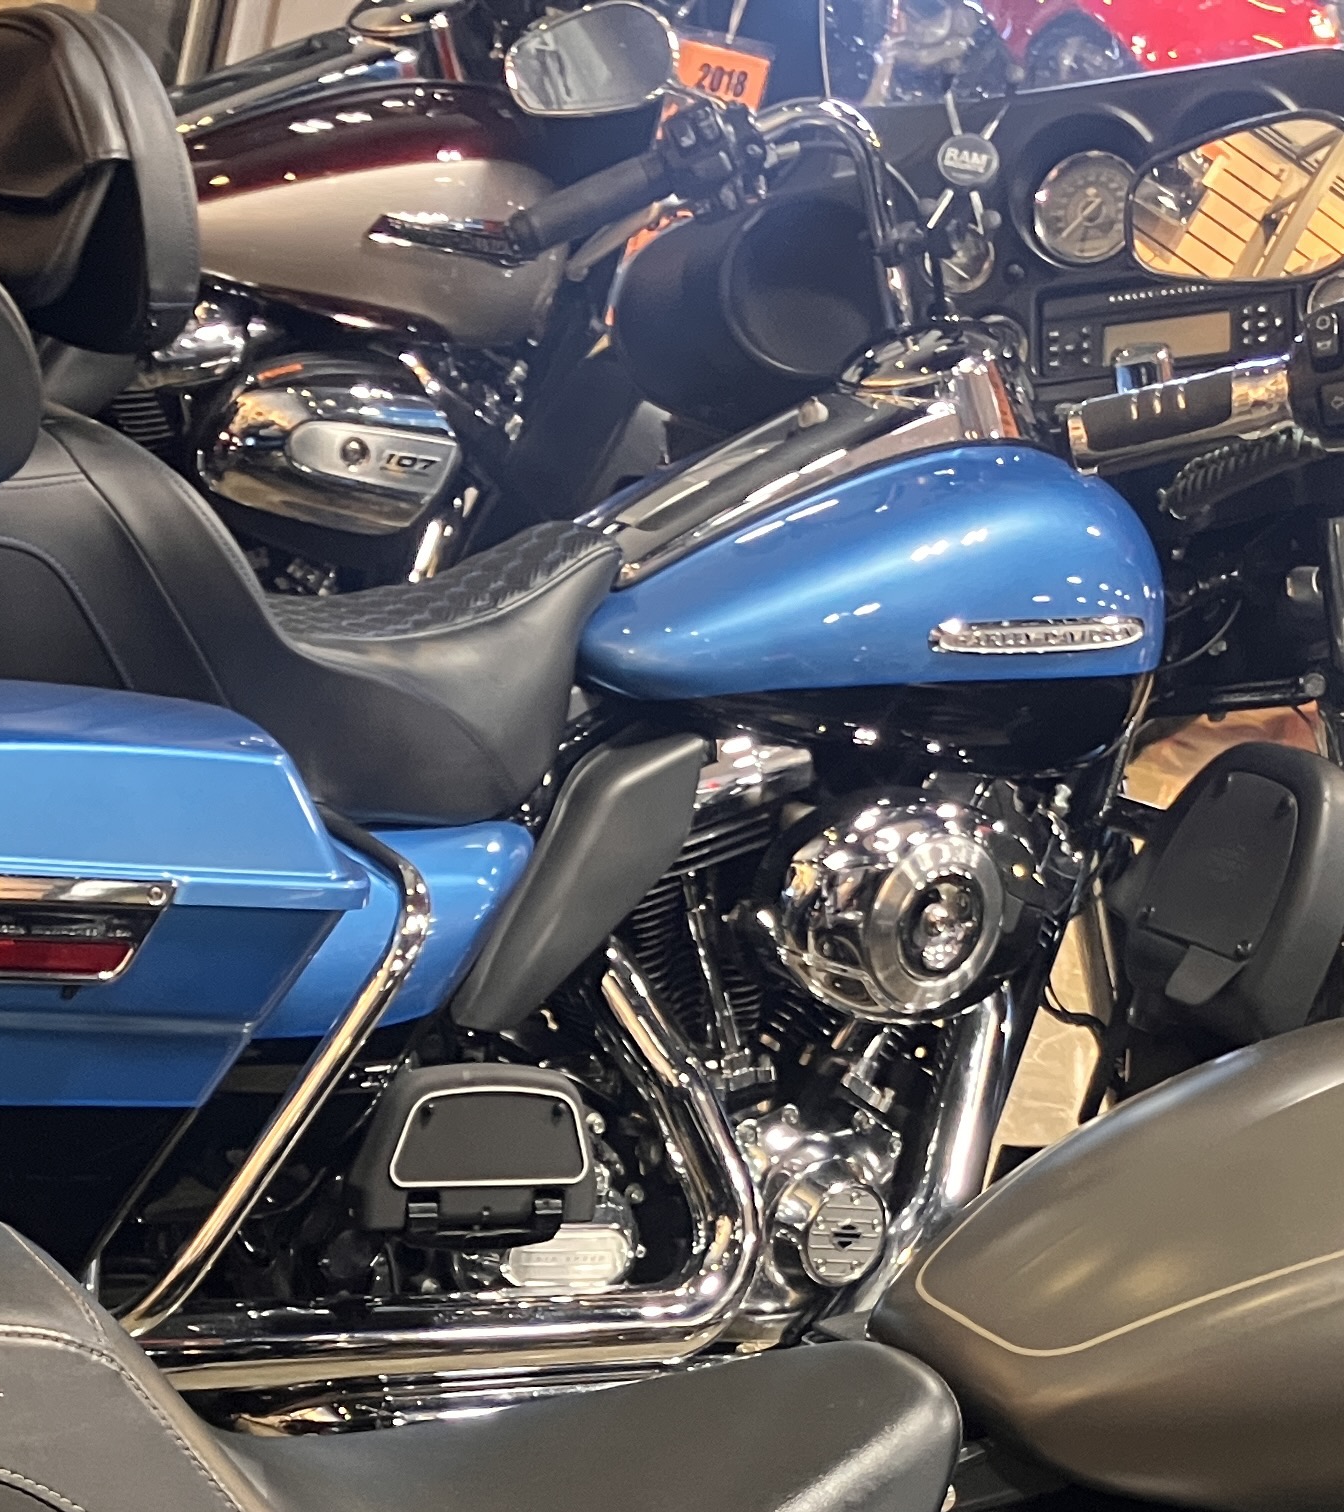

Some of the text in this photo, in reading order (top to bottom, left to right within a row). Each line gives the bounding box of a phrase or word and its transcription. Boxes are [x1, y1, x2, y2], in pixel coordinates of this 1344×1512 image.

[695, 63, 748, 98] 2018
[943, 146, 989, 174] RAM
[1108, 285, 1213, 302] HARLEY-DAVIDS
[384, 450, 441, 471] 107
